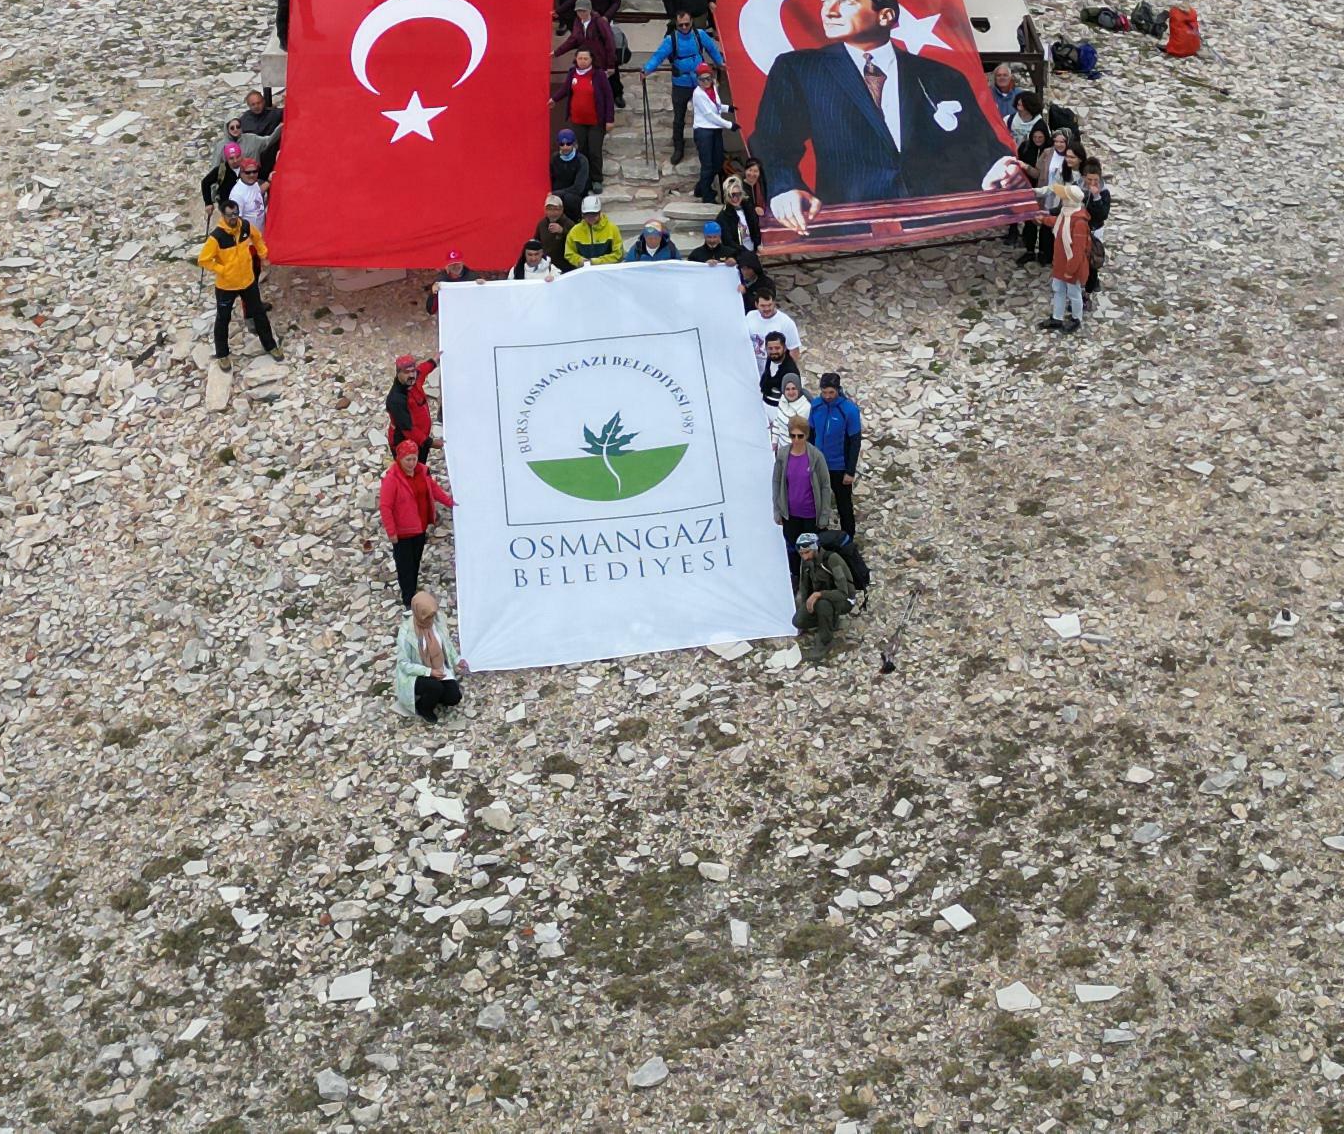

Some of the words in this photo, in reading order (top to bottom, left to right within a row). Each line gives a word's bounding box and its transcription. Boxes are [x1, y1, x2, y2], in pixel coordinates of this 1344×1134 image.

[523, 354, 606, 406] OSMANGAZİ
[516, 410, 532, 454] BURSA
[681, 410, 694, 435] 1987
[509, 512, 730, 561] OSMANGAZİ
[514, 544, 733, 588] BELEDİYESİ
